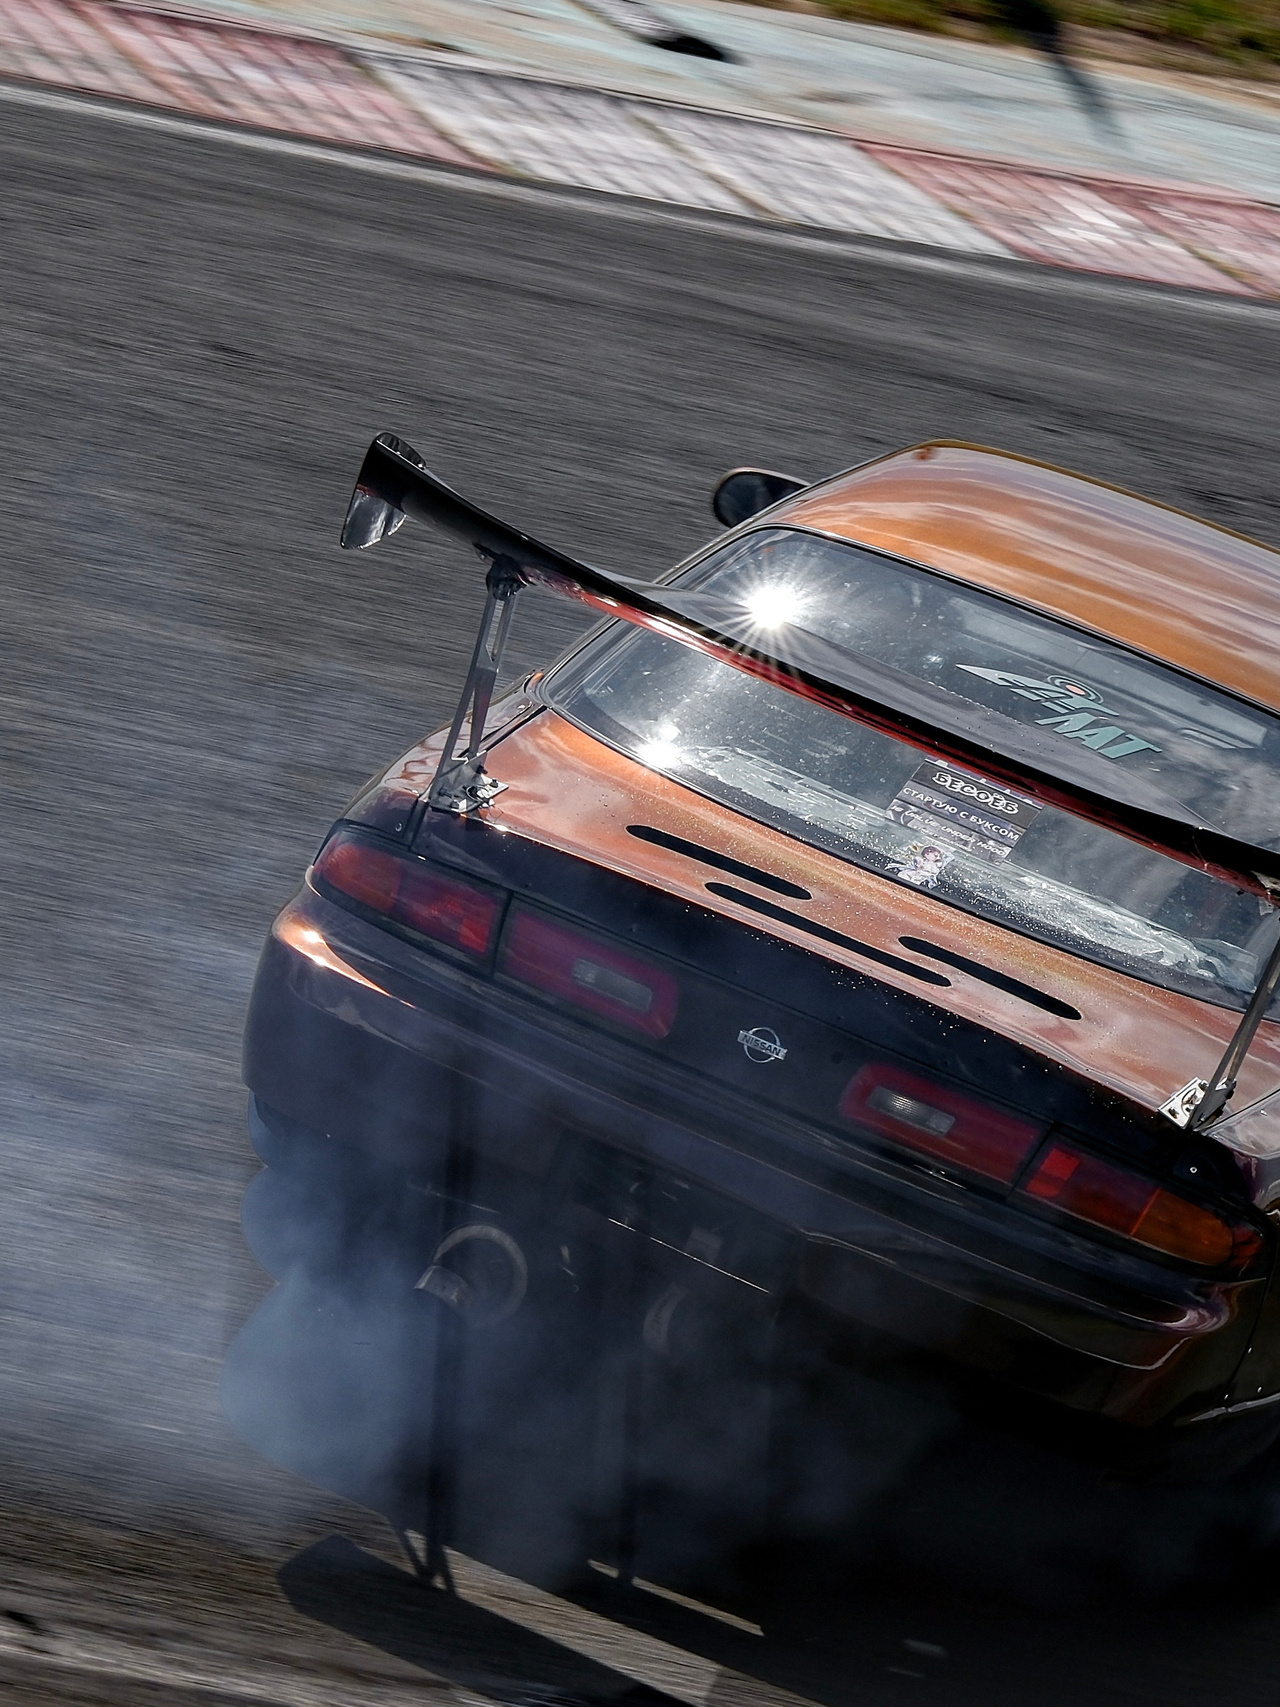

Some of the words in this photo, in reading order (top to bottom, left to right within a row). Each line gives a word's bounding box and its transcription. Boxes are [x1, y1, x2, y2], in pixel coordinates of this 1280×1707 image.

[903, 787, 958, 814] СТАРТУЮ
[959, 811, 969, 819] С
[969, 815, 1019, 841] БУКСОМ
[977, 841, 1006, 856] HOOD
[741, 1032, 784, 1058] NISSAN
